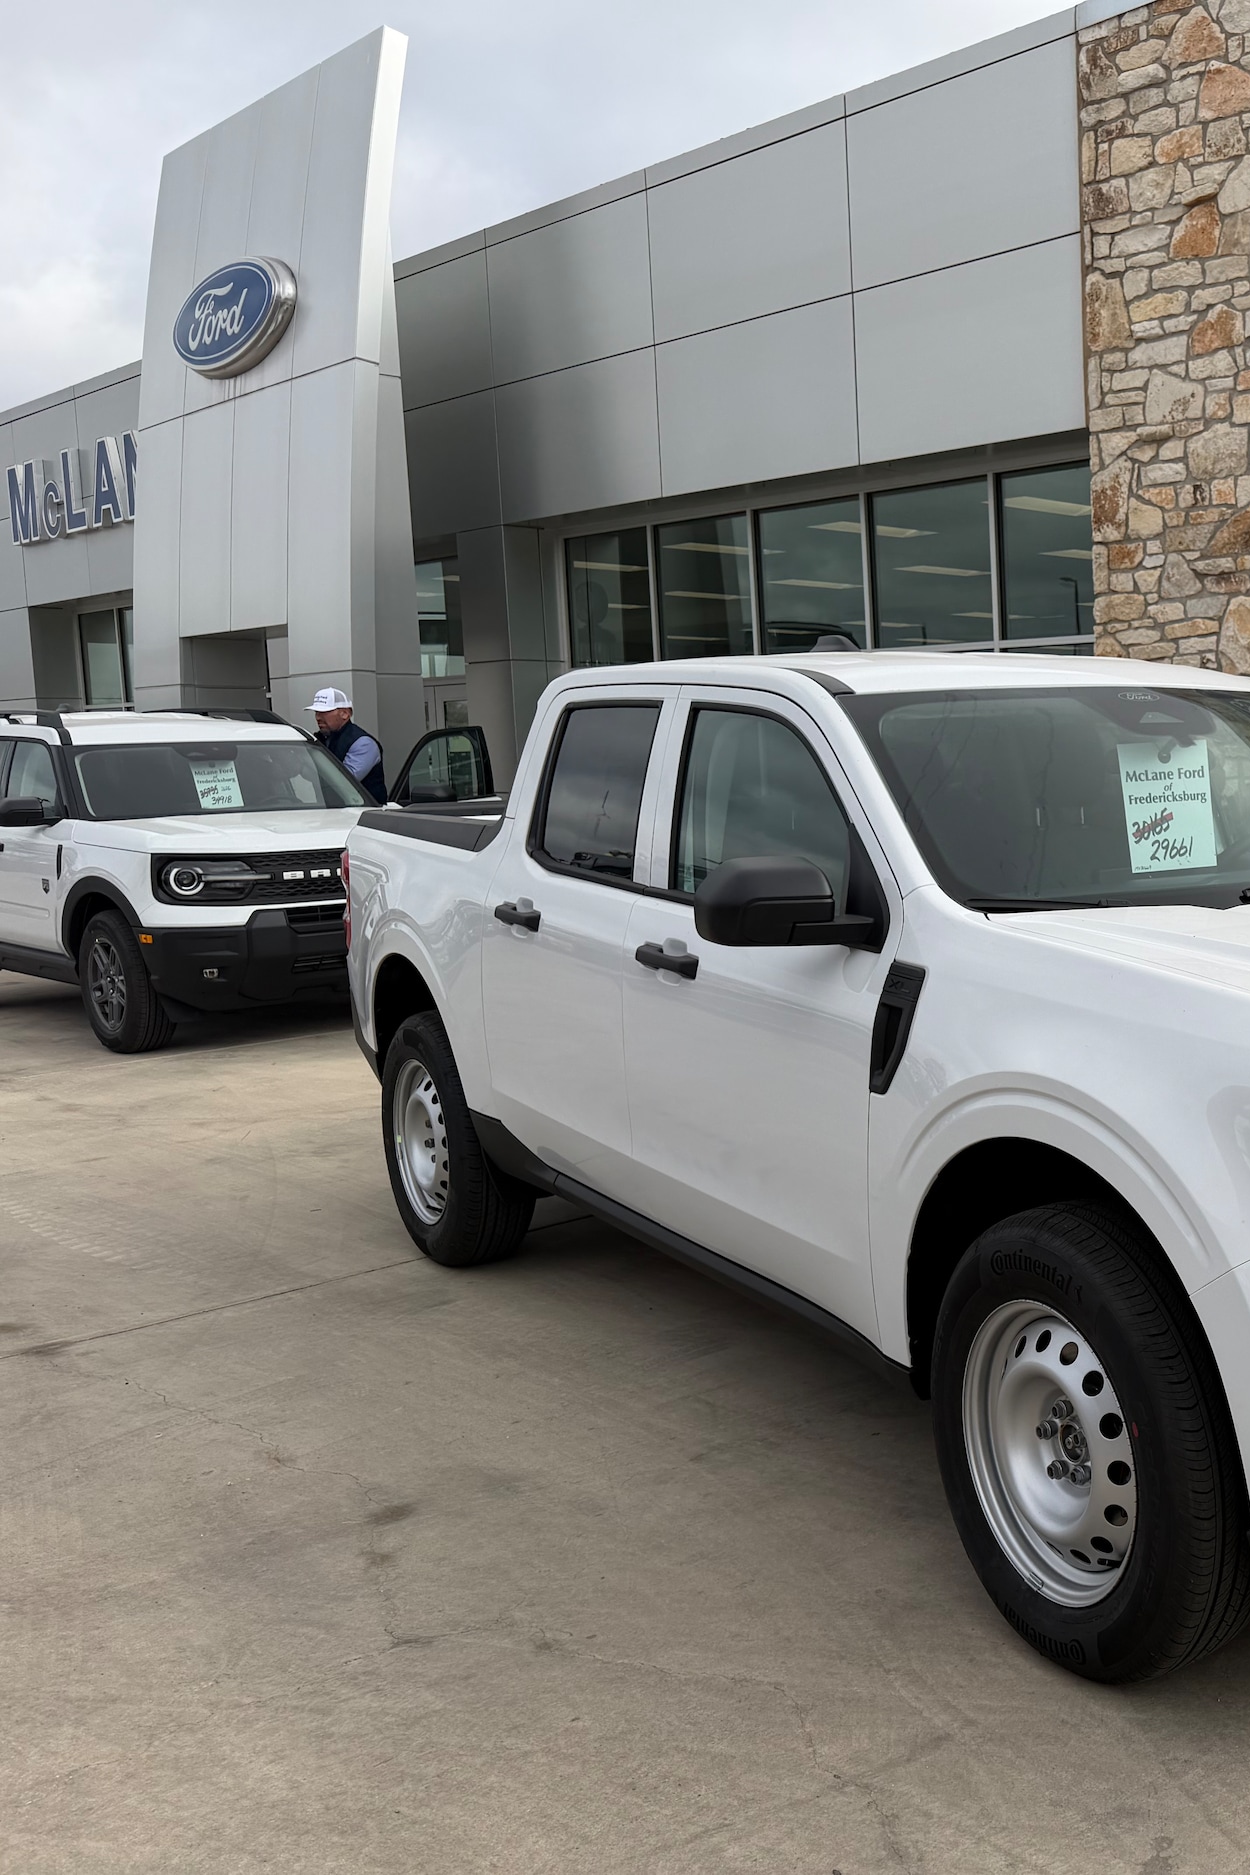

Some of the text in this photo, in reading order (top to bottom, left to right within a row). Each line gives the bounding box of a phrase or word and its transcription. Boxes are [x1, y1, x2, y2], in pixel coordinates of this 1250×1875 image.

[188, 281, 248, 351] Ford
[1125, 765, 1205, 783] McLane Ford
[1128, 790, 1207, 805] Fredericksburg
[1163, 782, 1173, 792] of
[1150, 836, 1193, 862] 29661
[990, 1248, 1072, 1296] Continental
